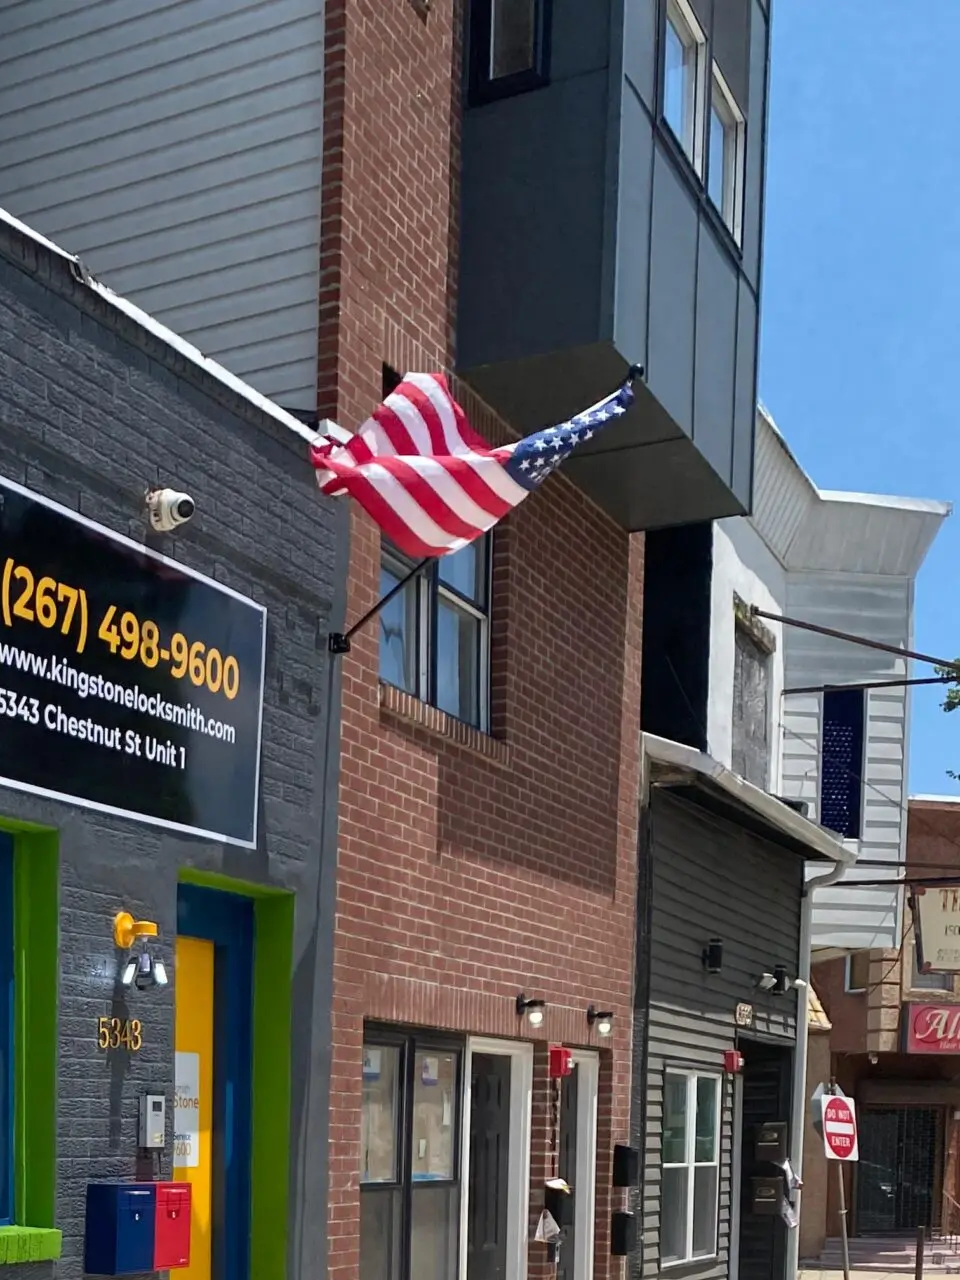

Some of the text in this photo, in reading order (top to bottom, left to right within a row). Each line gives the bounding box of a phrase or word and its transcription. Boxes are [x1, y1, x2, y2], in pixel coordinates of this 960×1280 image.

[1, 558, 241, 701] (267) 498-9600
[44, 704, 122, 750] Chestnut
[125, 729, 142, 757] St
[145, 735, 177, 768] Unit
[179, 747, 187, 770] 1
[98, 1016, 142, 1052] 5343
[826, 1108, 850, 1120] DO NOT
[831, 1136, 851, 1148] ENTER
